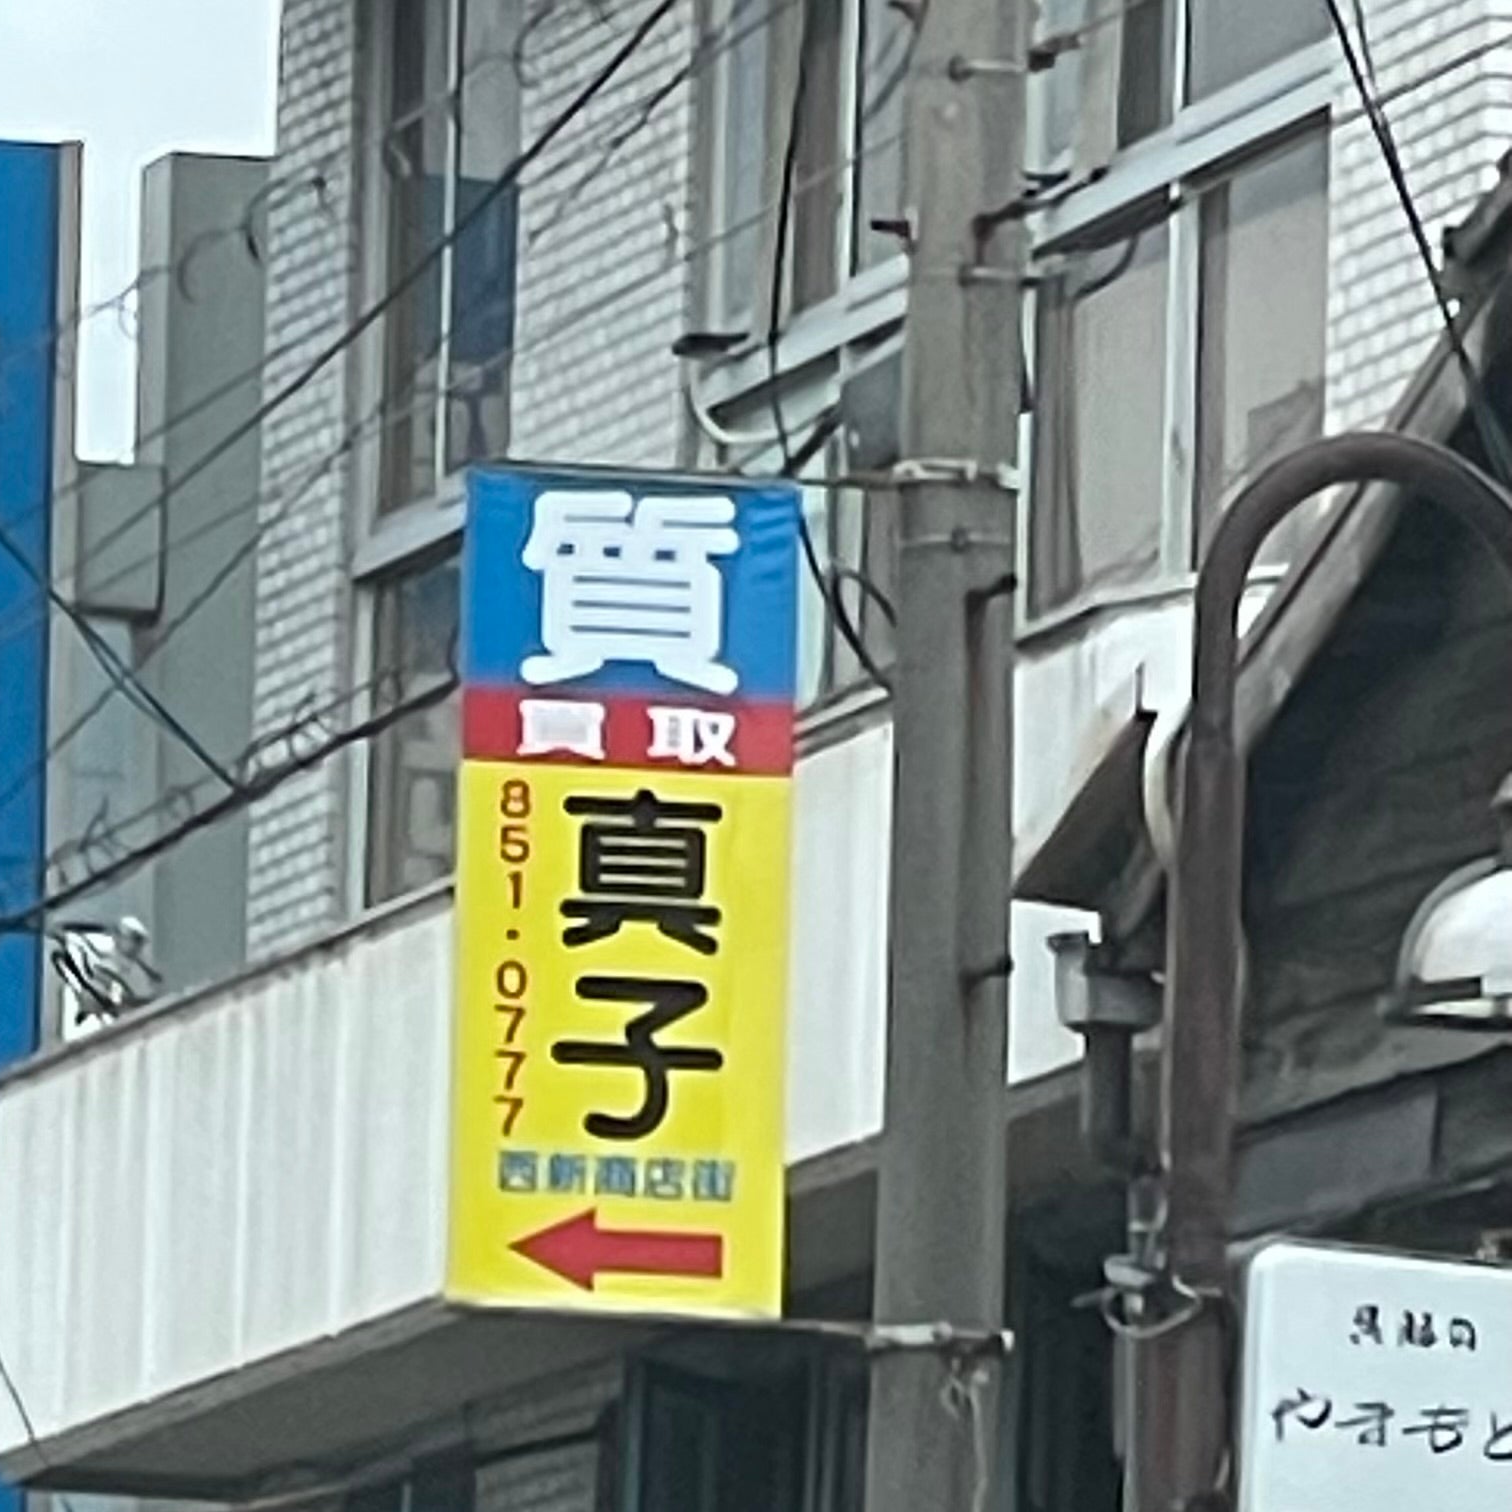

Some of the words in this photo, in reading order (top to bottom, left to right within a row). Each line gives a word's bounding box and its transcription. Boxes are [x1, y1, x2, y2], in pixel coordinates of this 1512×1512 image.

[520, 490, 741, 695] 質
[517, 699, 736, 767] 買取
[550, 788, 724, 1141] 真子
